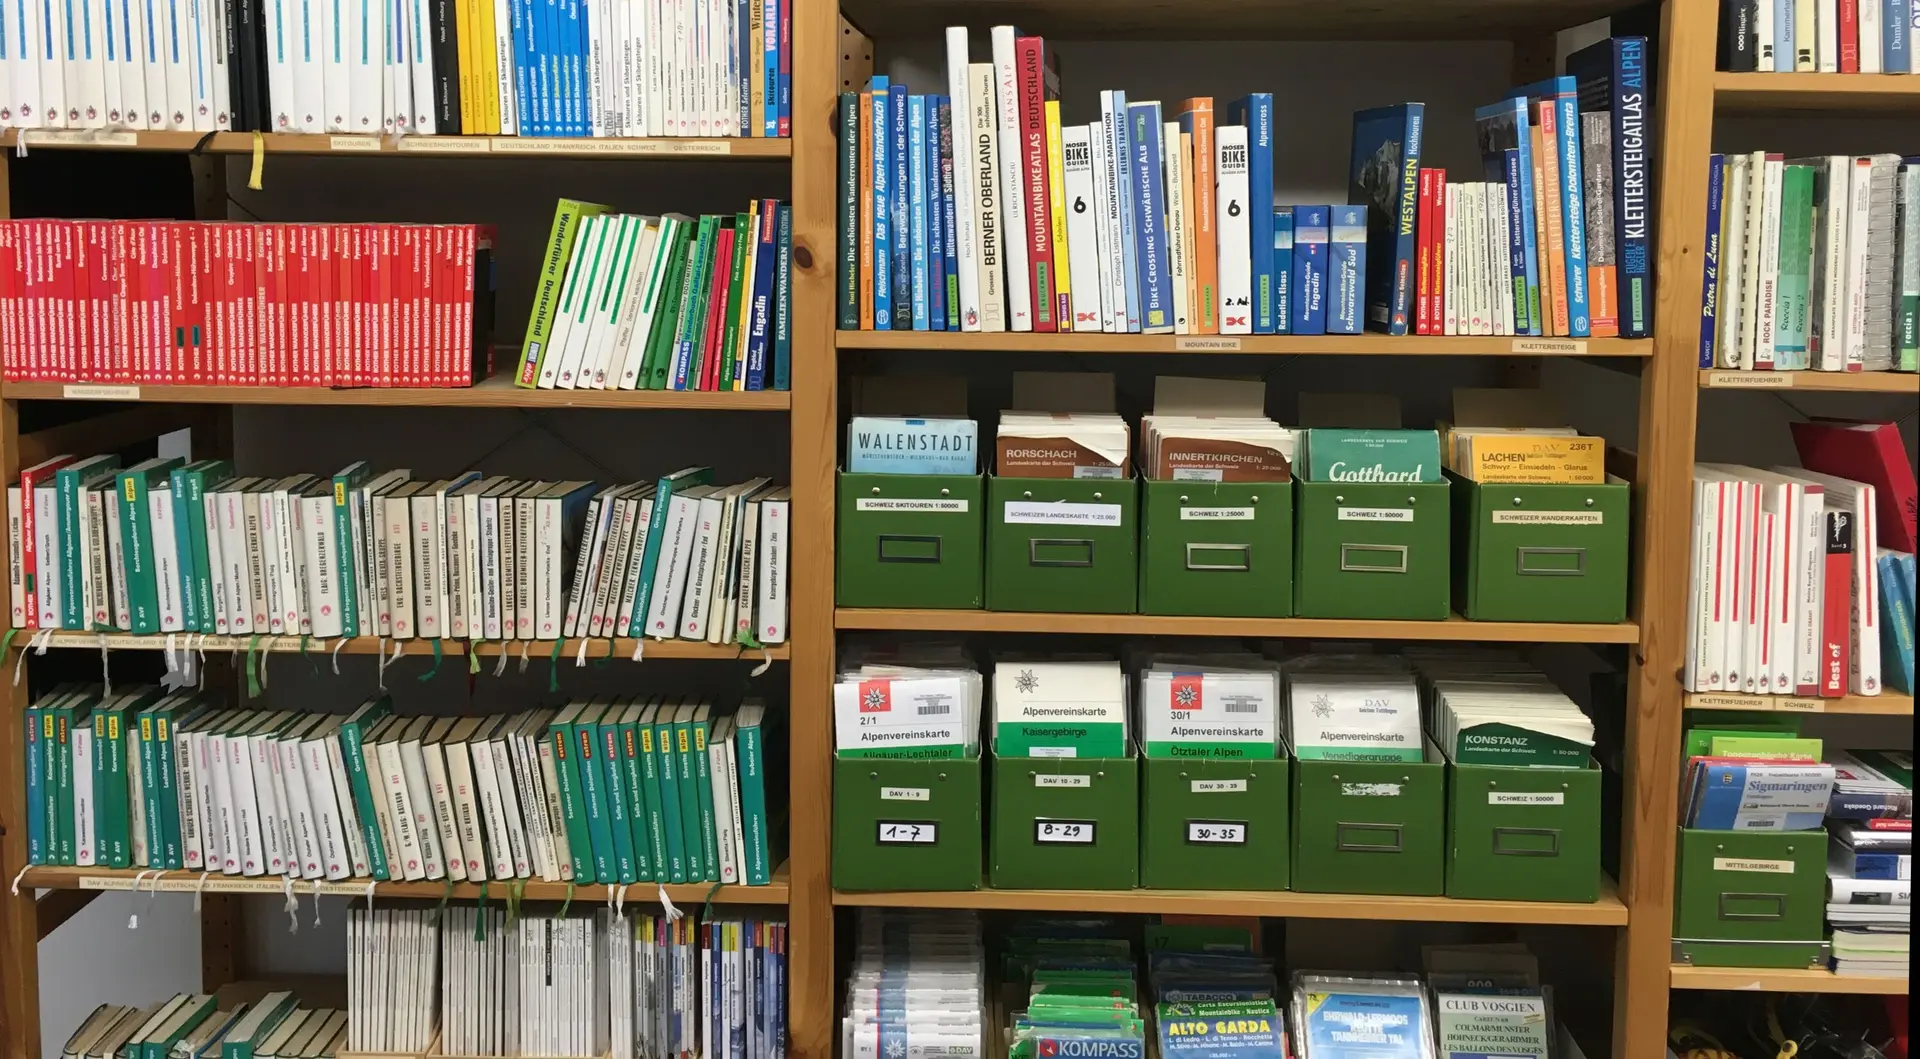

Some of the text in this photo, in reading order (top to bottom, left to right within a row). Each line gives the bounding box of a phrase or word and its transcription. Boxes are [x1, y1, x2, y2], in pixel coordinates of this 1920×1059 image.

[1892, 16, 1901, 50] Dumler
[847, 104, 857, 128] Alpen
[1259, 105, 1268, 147] Alpencross
[1544, 109, 1552, 131] Alpen
[847, 130, 856, 144] der
[1621, 40, 1645, 238] KLETTERSTEIGATLAS ALPEN
[1026, 49, 1046, 252] MOUNTAINBIKEATLAS DEUTSCHLAND
[1065, 149, 1088, 161] BIKE
[1221, 150, 1245, 163] BIKE
[847, 145, 856, 203] Wanderrouten
[895, 94, 908, 249] Bergwanderungen in der Schweiz
[1104, 112, 1117, 219] MOUNTAINBIKE-MARATHON
[1401, 116, 1420, 235] WESTALPEN Hochtouren
[943, 164, 953, 193] Südtirol
[873, 100, 887, 297] Fleischmann Das neue Alpen-Wanderbuch
[979, 134, 996, 266] BERNER OBERLAND
[1074, 197, 1087, 214] 6
[1228, 199, 1241, 217] 6
[1510, 157, 1522, 245] Klettersteigführer Gardasee
[1564, 102, 1584, 303] Schnürer Klettersteige Dolomiten-Brenta
[780, 209, 789, 235] SÜDTIROL
[847, 205, 856, 245] schönsten
[945, 203, 955, 257] Hüttenwandern
[847, 247, 856, 261] Die
[533, 213, 570, 336] Wanderführer Deutschland
[1703, 233, 1718, 317] Pietra di Luna
[778, 247, 787, 340] FAMILIENWANDERN
[1279, 271, 1287, 330] Radatlas Elsass
[1311, 272, 1320, 311] Engadin
[1346, 249, 1357, 331] Schwarzwald Süd
[753, 295, 766, 336] Engadin
[1763, 280, 1772, 343] ROCK PARADISE
[1780, 301, 1791, 331] Roccia
[1904, 318, 1912, 343] roccia
[1521, 343, 1577, 351] KLETTERSTEIGE
[678, 341, 690, 378] KOMPASS
[858, 433, 972, 452] WALENSTADT
[1006, 449, 1077, 458] RORSCHACH
[1169, 452, 1263, 464] INNERTKIRCHEN
[1481, 453, 1526, 462] LACHEN
[1329, 462, 1423, 483] Gotthard
[1482, 464, 1510, 472] Schwyz
[1346, 510, 1376, 518] SCHWEIZ
[1500, 514, 1598, 522] SCHWEIZER WANDERKARTEN
[1829, 643, 1841, 689] Best of
[1023, 707, 1107, 717] Alpenvereinskarte
[1700, 698, 1763, 706] KLETTERFUEHRER
[1784, 701, 1815, 709] SCHWEIZ
[860, 717, 877, 725] 2/1
[1171, 711, 1190, 720] 30/1
[861, 729, 950, 741] Alpenvereinskarte
[1022, 727, 1087, 738] Kaisergebirge
[1171, 727, 1263, 737] Alpenvereinskarte
[1320, 731, 1404, 742] Alpenvereinskarte
[1465, 735, 1528, 746] KONSTANZ
[1171, 747, 1243, 758] Ötztaler Alpen
[1748, 781, 1827, 792] Sigmaringen
[1725, 862, 1779, 870] MITTELGEBIRGE
[1446, 1000, 1535, 1012] CLUB VOSGIEN
[1169, 1019, 1271, 1036] ALTO GARDA
[1059, 1039, 1139, 1058] KOMPASS
